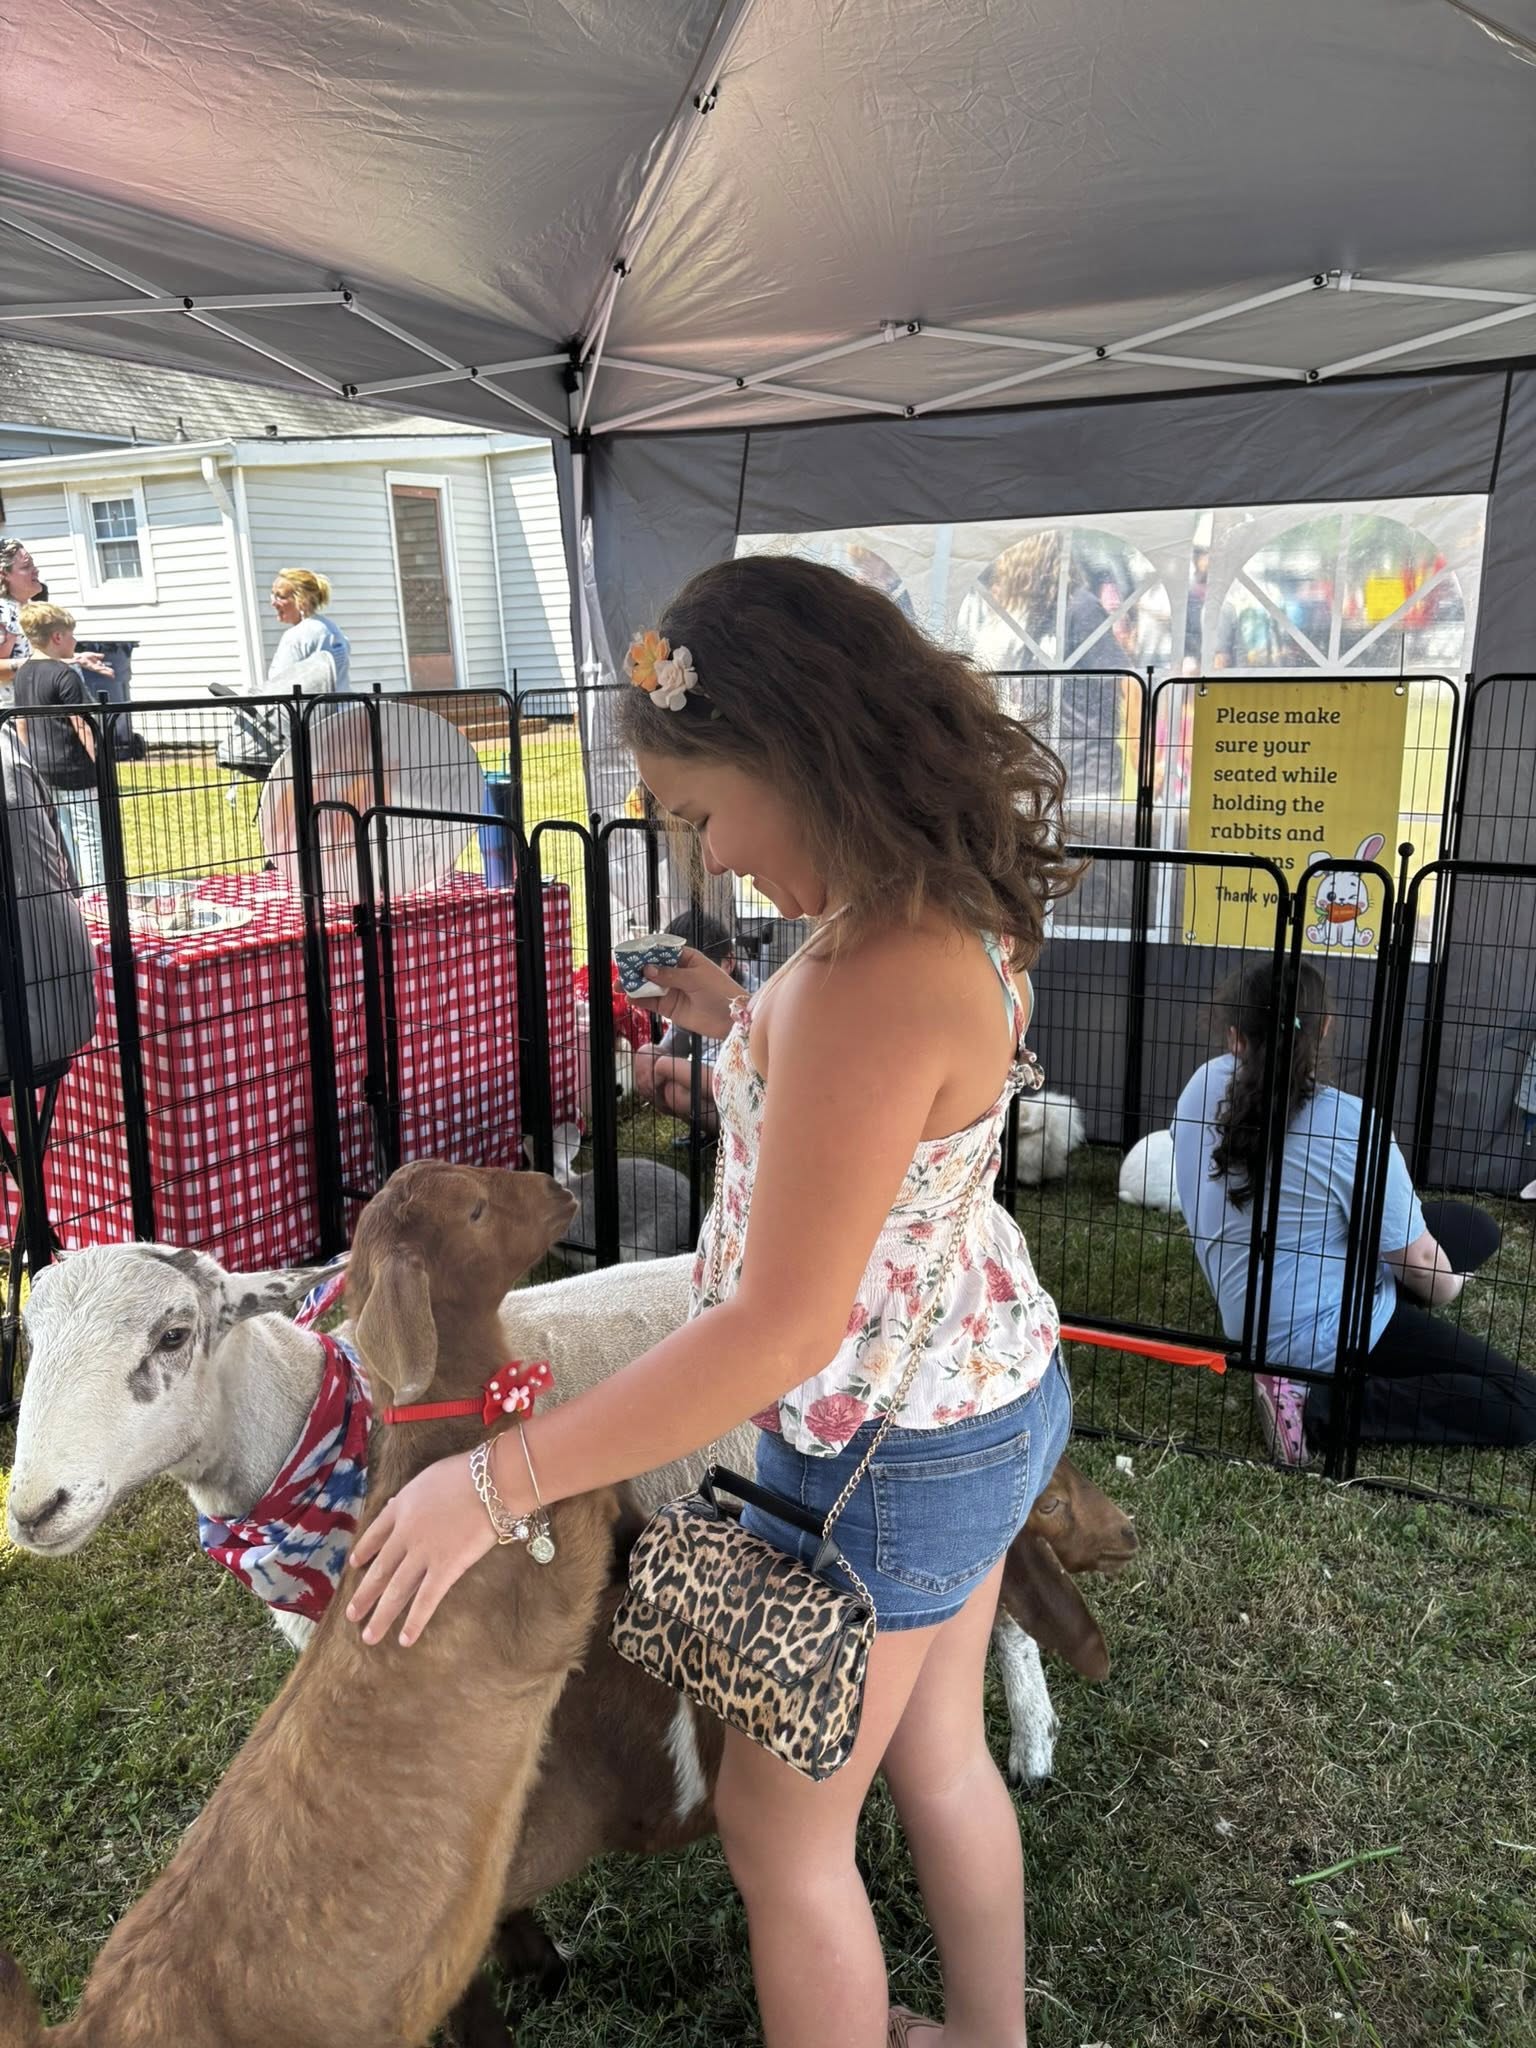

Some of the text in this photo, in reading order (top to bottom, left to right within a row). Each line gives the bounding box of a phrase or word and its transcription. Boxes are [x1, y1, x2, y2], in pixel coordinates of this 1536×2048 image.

[1216, 707, 1341, 725] Please make
[1215, 740, 1311, 757] sure your
[1213, 766, 1338, 784] seated while
[1212, 795, 1325, 815] holding the
[1211, 823, 1325, 842] rabbits and
[1216, 886, 1279, 908] Thank yo
